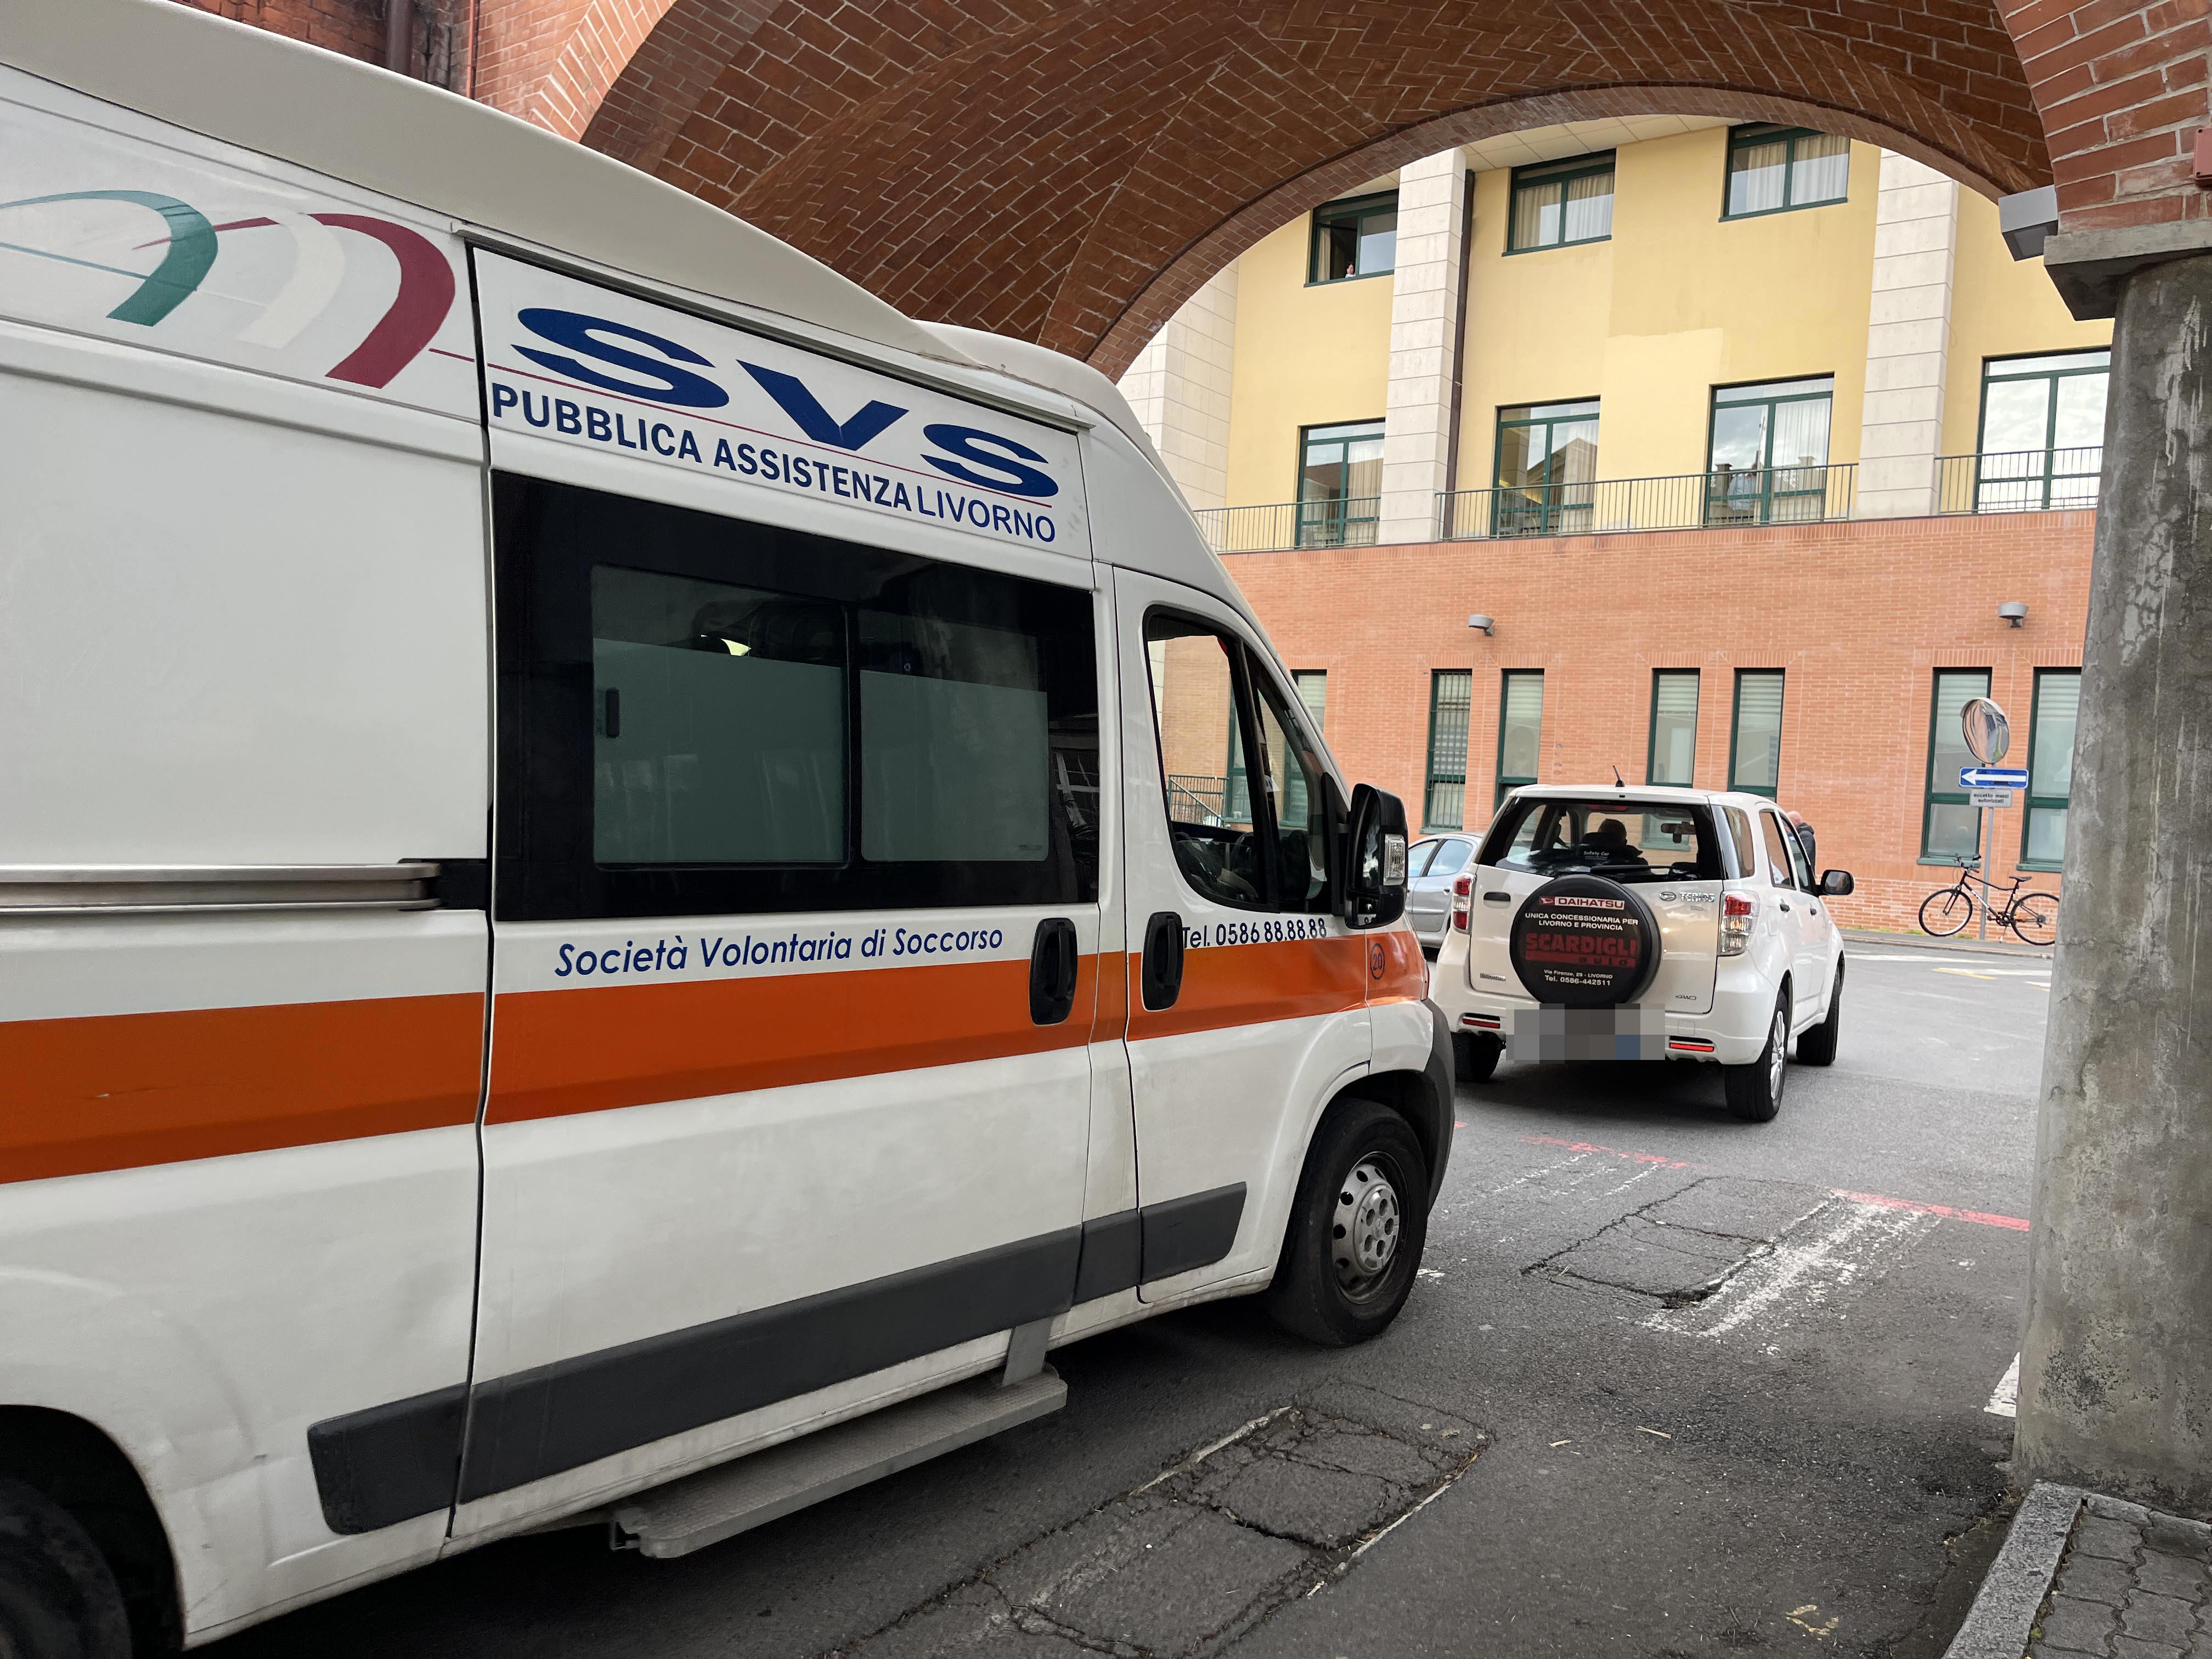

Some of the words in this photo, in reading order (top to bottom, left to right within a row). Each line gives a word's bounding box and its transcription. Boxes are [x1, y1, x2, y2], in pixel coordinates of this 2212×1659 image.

[511, 308, 1059, 498] SVS
[492, 382, 702, 463] PUBBLICA
[714, 438, 912, 510] ASSISTENZA
[917, 487, 1056, 543] LIVORNO
[1558, 898, 1624, 909] DAIHATSU
[1550, 913, 1620, 924] CONCESSIONARIA
[1581, 922, 1623, 931] PROVINCIA
[1183, 926, 1210, 948] Tel.
[1216, 922, 1260, 946] 0586
[1264, 917, 1327, 943] 88.88.88
[1526, 933, 1637, 956] SCARDIGLI
[554, 935, 688, 977] Società
[701, 931, 852, 967] Volontaria
[861, 928, 886, 957] di
[892, 928, 1003, 956] Soccorso
